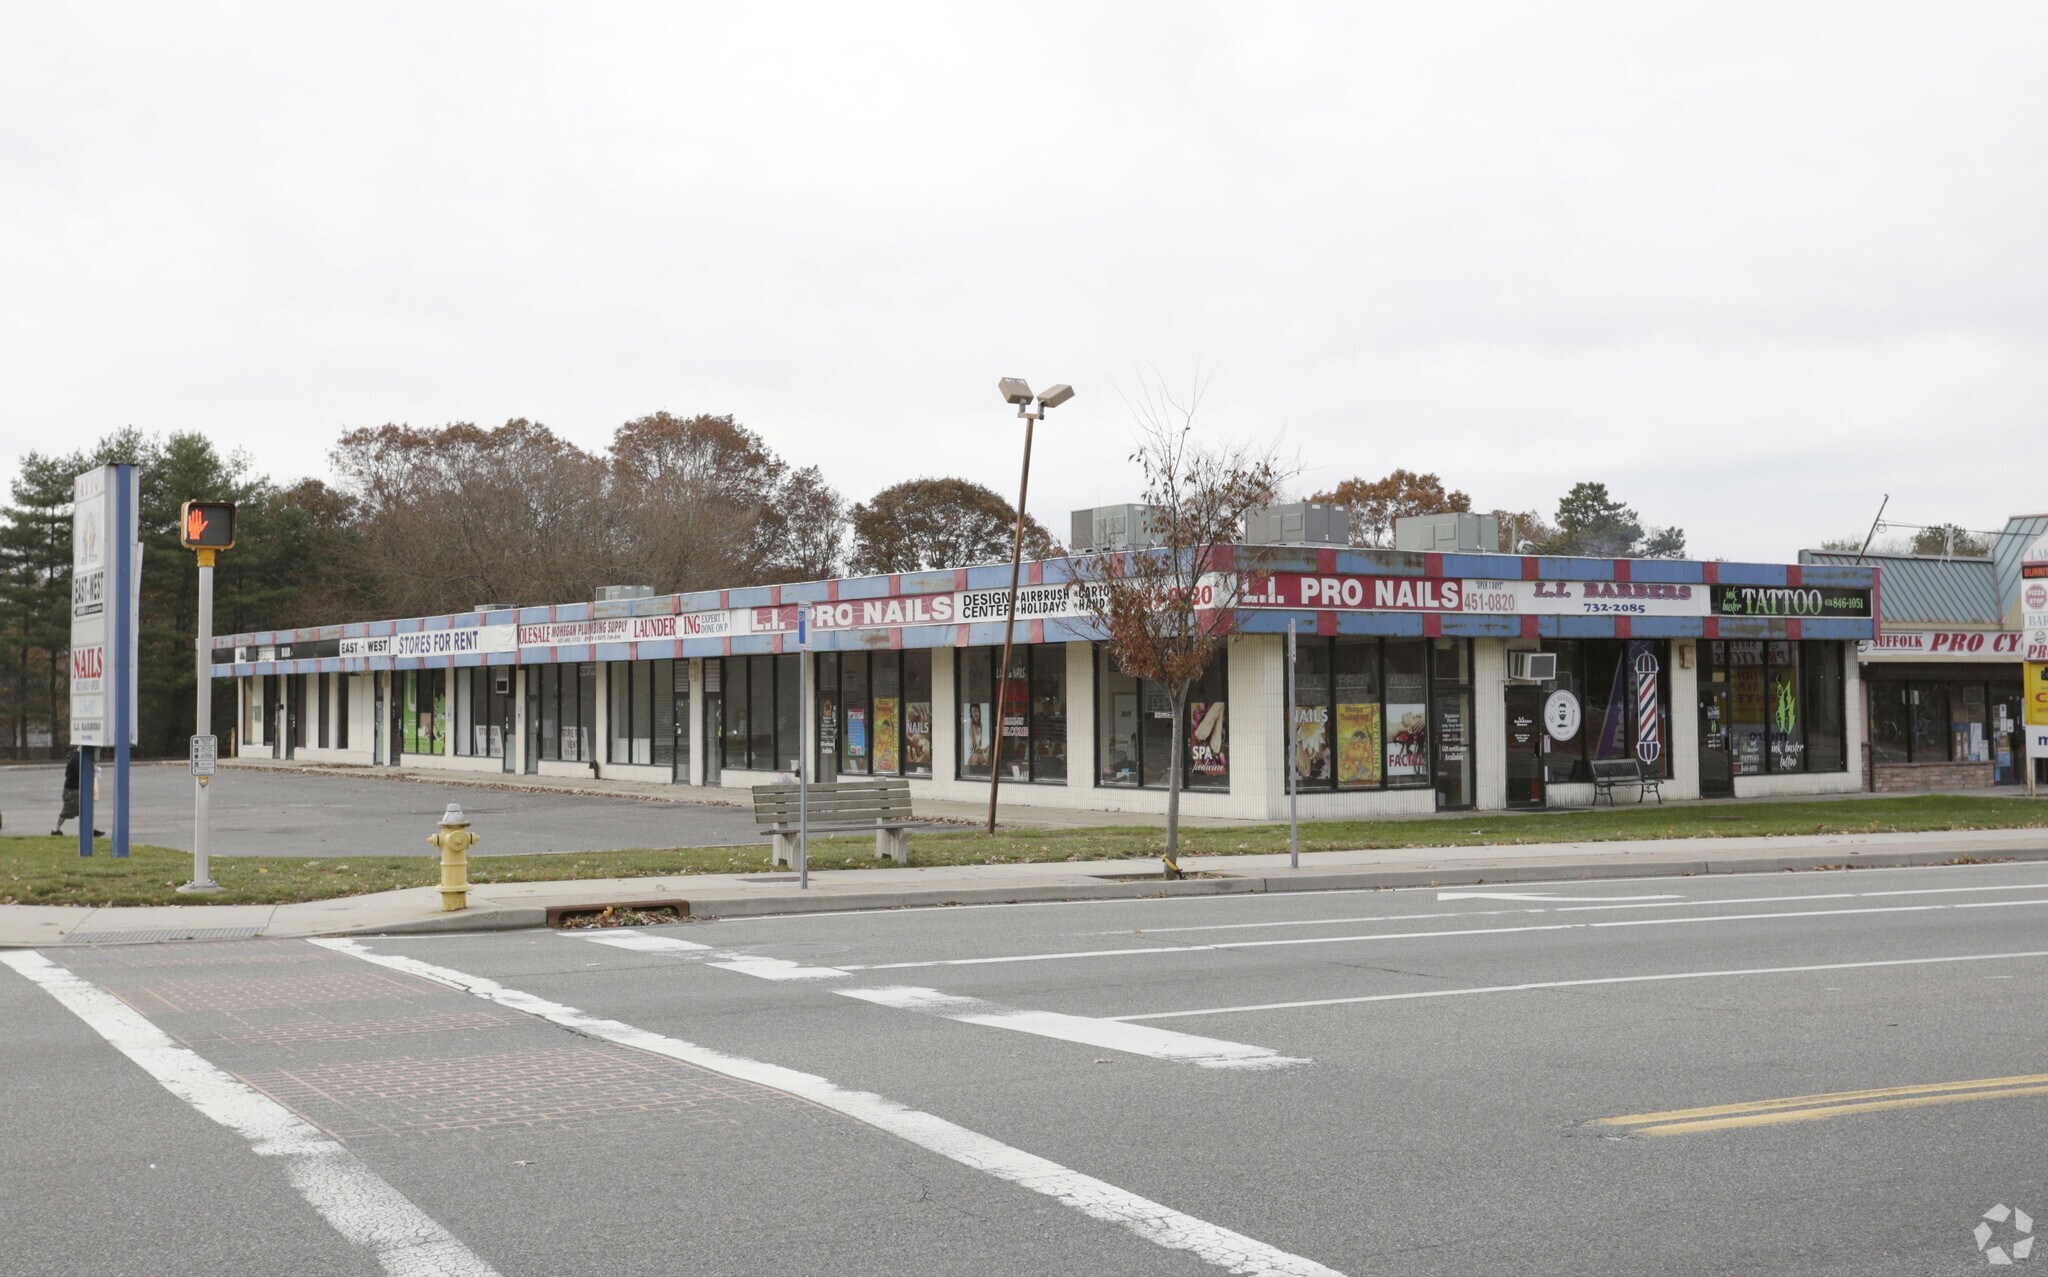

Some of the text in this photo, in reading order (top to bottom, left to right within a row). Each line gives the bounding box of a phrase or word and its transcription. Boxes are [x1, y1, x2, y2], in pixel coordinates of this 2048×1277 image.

[963, 591, 1011, 607] DESIGN
[1079, 585, 1110, 598] CARTO
[1301, 577, 1363, 606] PRO
[1375, 579, 1459, 608] NAILS
[1534, 582, 1692, 601] L.I. BARBERS
[1464, 592, 1515, 611] 451-0820
[1583, 602, 1646, 614] 732-2085
[1741, 588, 1823, 615] TATTOO
[2029, 596, 2045, 604] STOP
[751, 596, 952, 631] L.I. RO NAILS
[519, 625, 550, 644] OLESALE
[578, 620, 606, 636] PLUMBING
[607, 620, 628, 634] SUPPLY
[341, 642, 358, 654] EAST
[368, 639, 388, 652] WEST
[399, 630, 478, 655] STORES FOR RENT
[1873, 633, 2023, 653] SUFFOLK PRO CY
[2027, 643, 2048, 659] PR
[73, 647, 102, 679] NAILS
[906, 721, 929, 734] NAILS
[1003, 726, 1028, 736] ELCOME
[1192, 745, 1213, 760] SPA
[1192, 760, 1225, 774] pedicure
